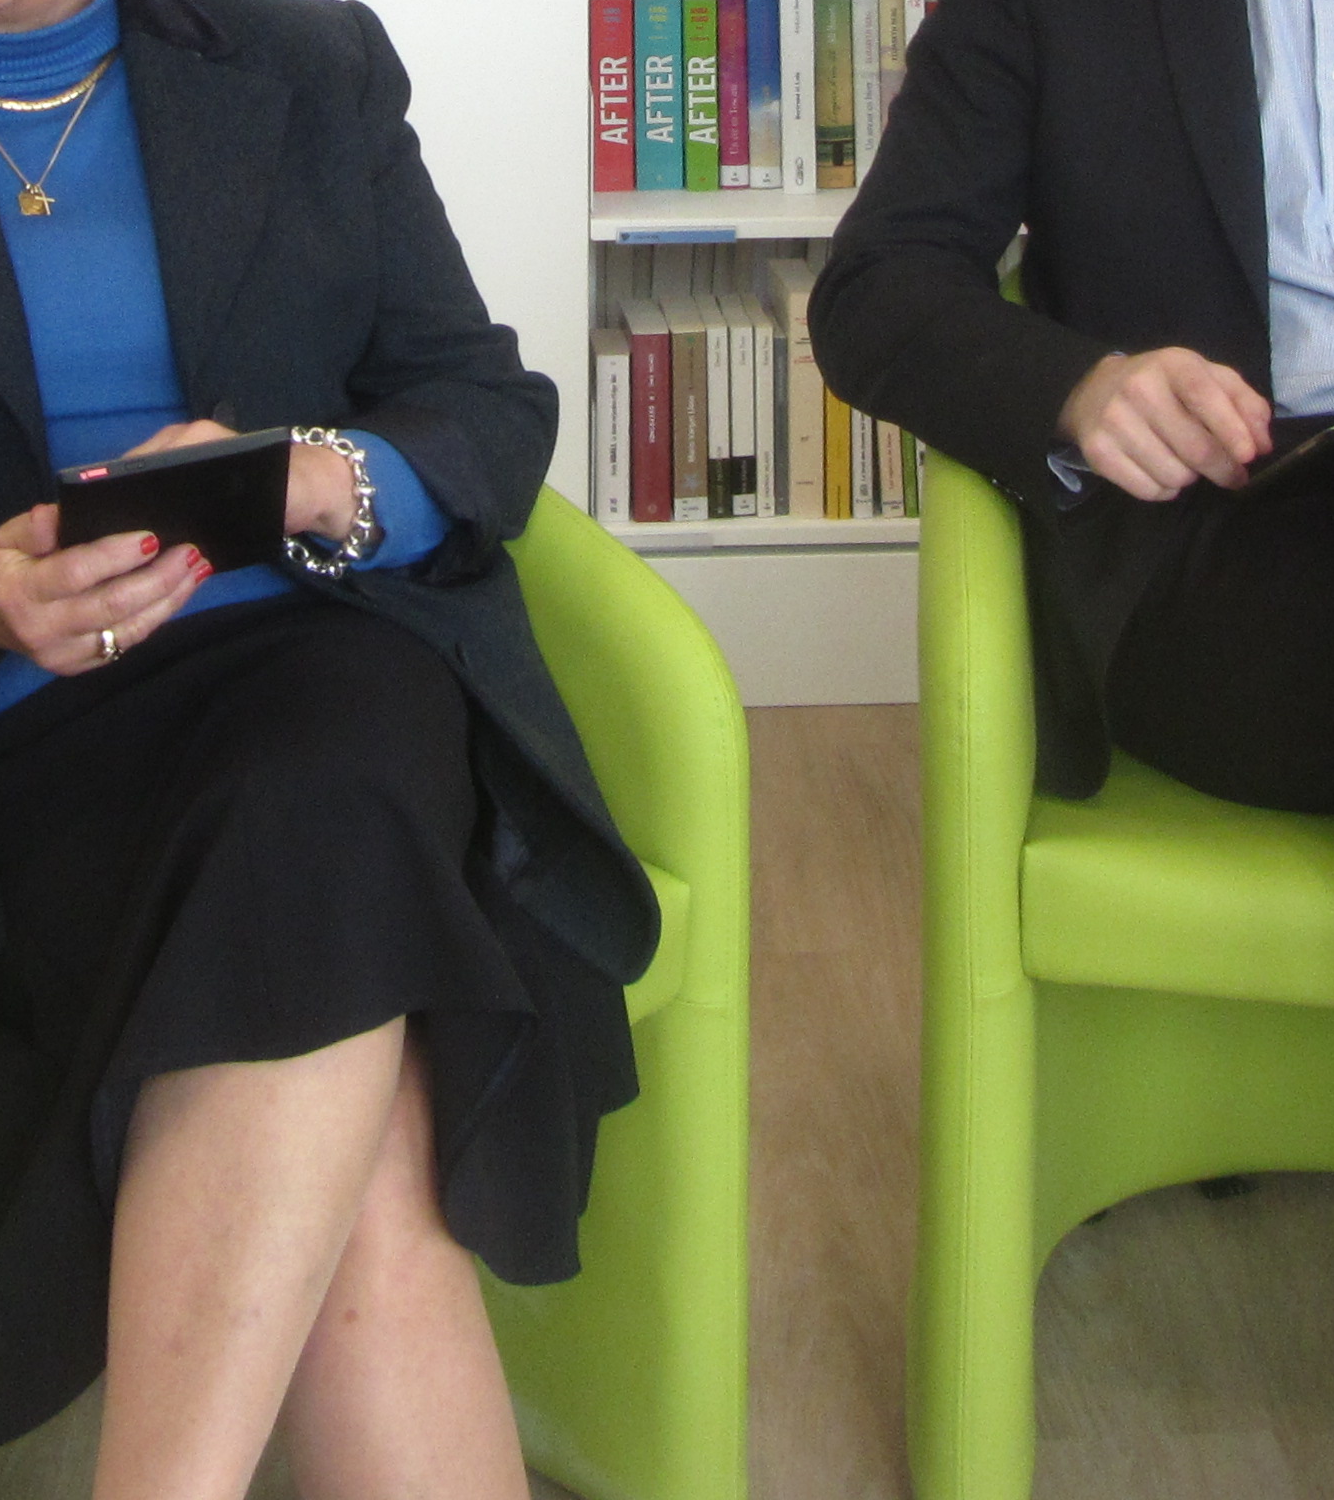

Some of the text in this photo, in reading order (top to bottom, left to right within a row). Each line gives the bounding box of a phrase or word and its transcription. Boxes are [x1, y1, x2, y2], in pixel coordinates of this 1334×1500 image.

[599, 56, 629, 145] AFTER
[645, 55, 674, 143] AFTER
[687, 55, 718, 144] AFTER
